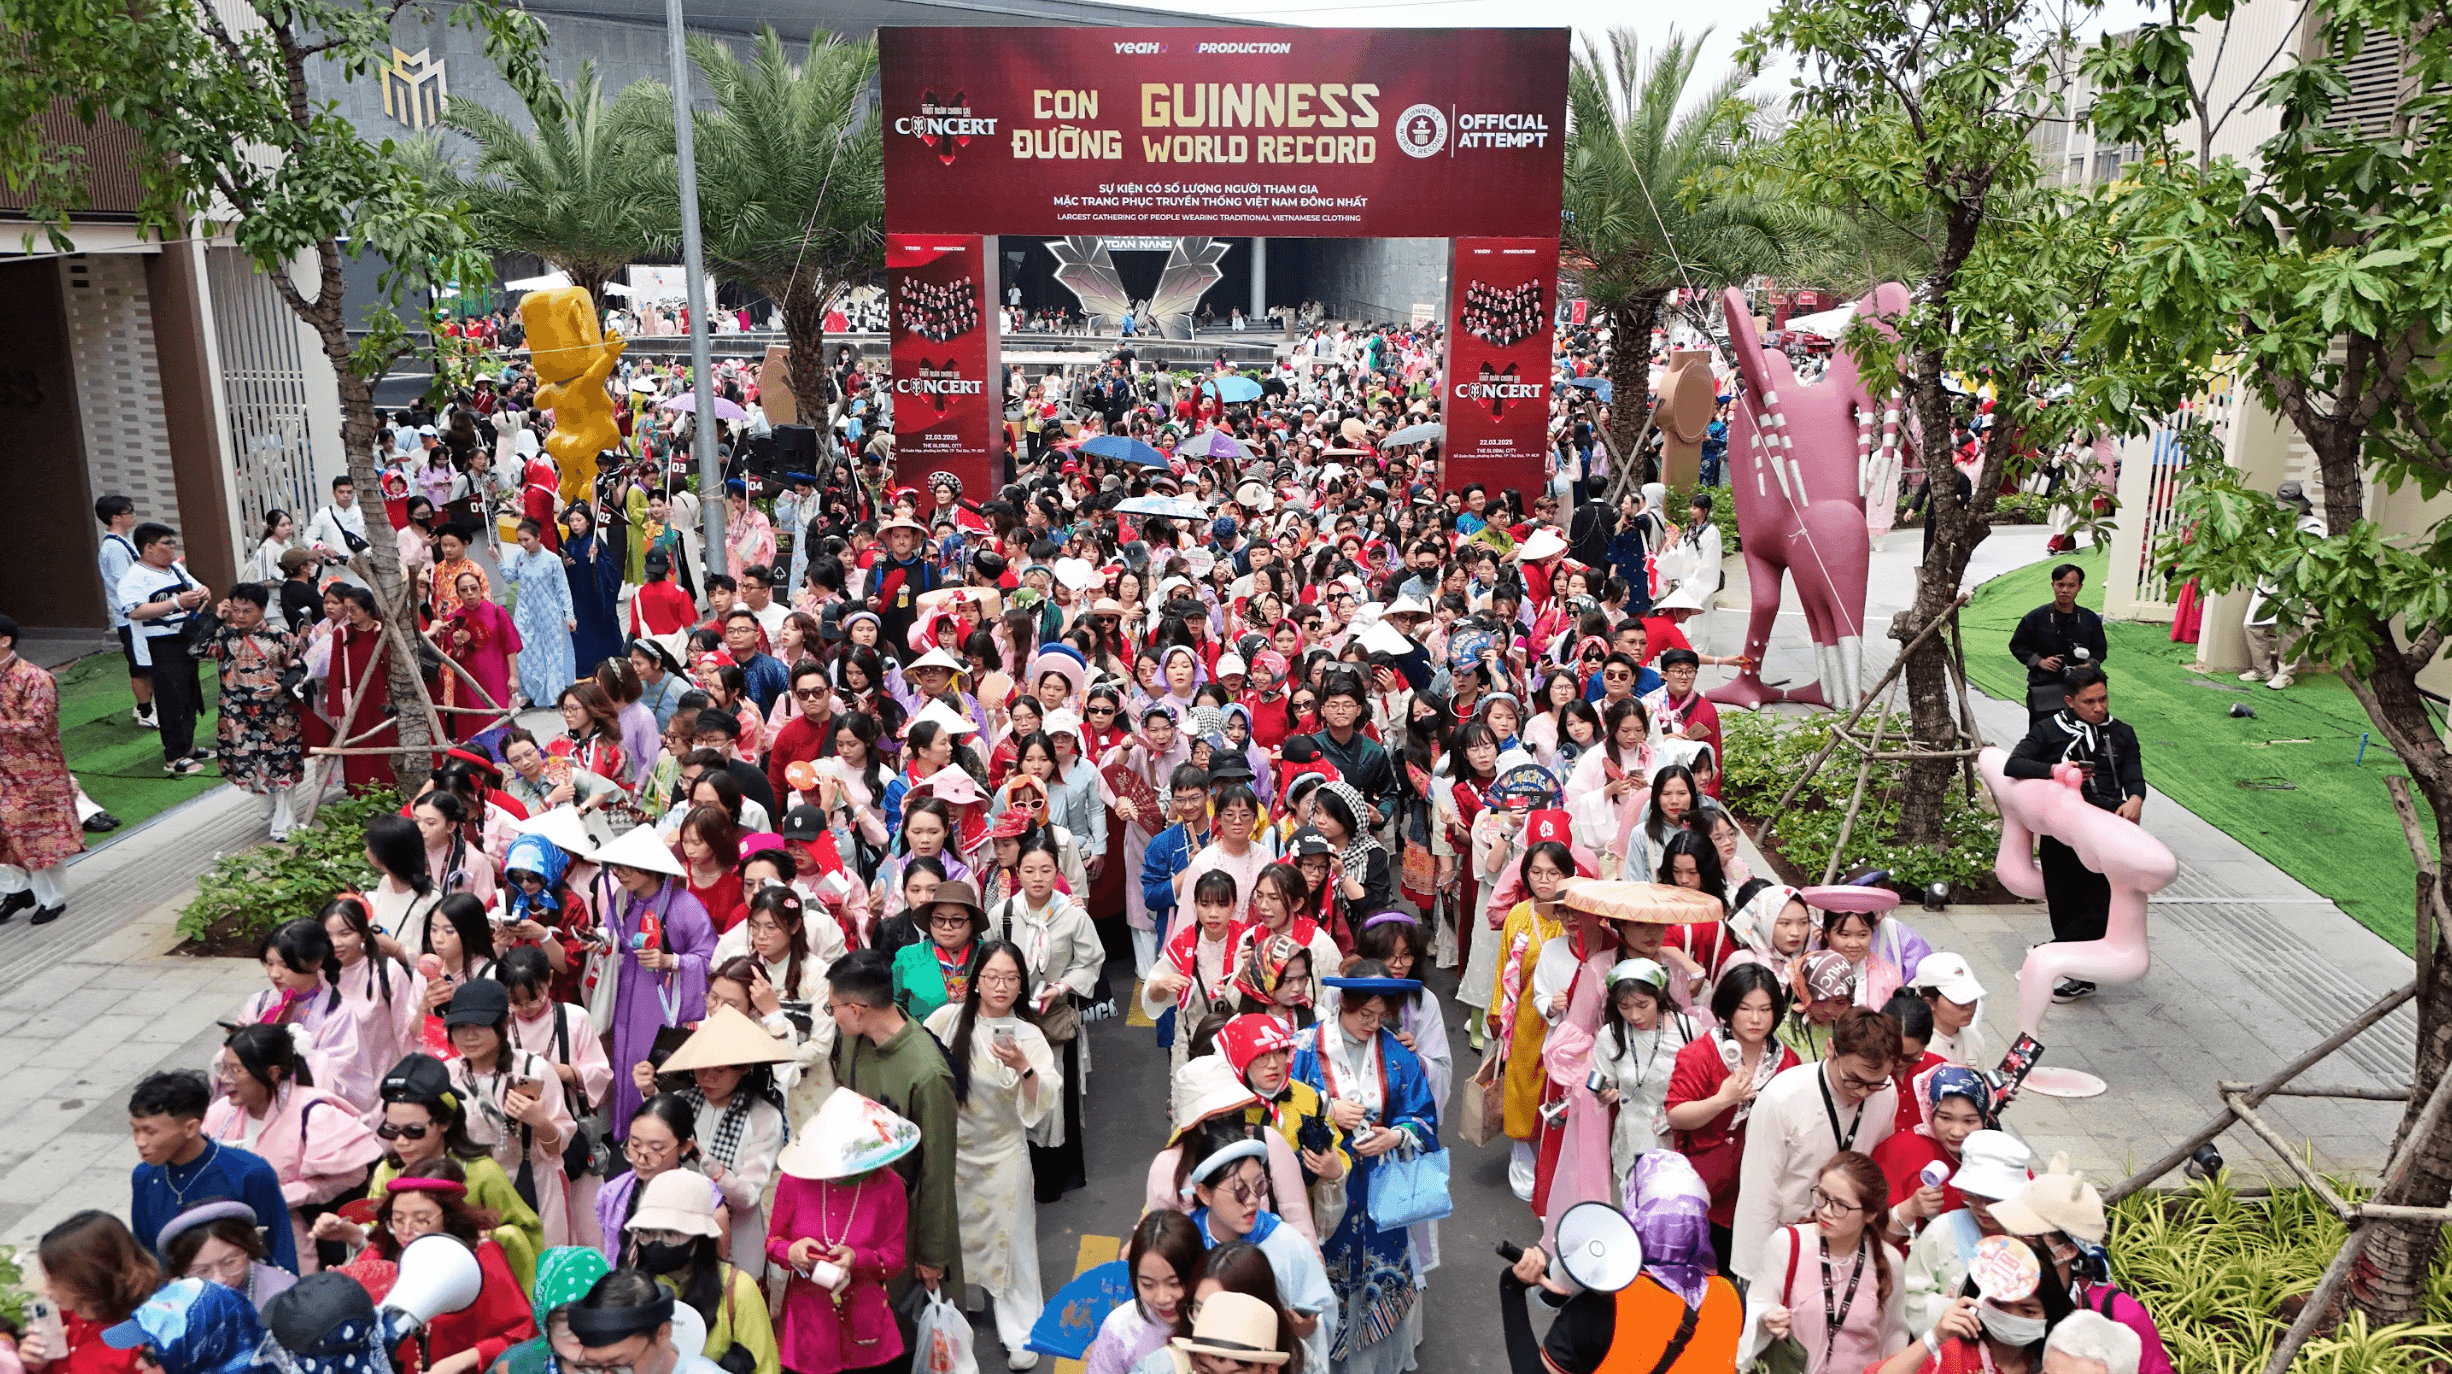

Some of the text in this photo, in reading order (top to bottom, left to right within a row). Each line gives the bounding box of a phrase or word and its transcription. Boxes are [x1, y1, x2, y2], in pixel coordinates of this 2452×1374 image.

[1199, 42, 1292, 54] PRODUCTION
[1033, 89, 1098, 119] CON
[1141, 83, 1380, 128] GUINNESS
[1403, 107, 1441, 122] GUINNESS
[1459, 114, 1548, 130] OFFICIAL
[1011, 124, 1122, 159] ĐƯỜNG
[1400, 127, 1444, 155] WORLD RECORDS
[1458, 132, 1548, 148] ATTEMPT
[1142, 135, 1376, 163] WORLD RECORD
[1099, 181, 1319, 195] SỰ KIỆN CÓ SỐ LƯỢNG NGƯỜI THAM GIA
[1053, 195, 1079, 208] MẶC
[1081, 197, 1119, 206] TRANG
[1122, 197, 1153, 208] PHỤC
[1202, 195, 1242, 206] THỐNG
[1244, 195, 1269, 208] VIỆT
[1271, 198, 1298, 207] NAM
[1300, 196, 1334, 207] ĐÔNG
[1336, 195, 1368, 207] NHẤT
[1057, 213, 1091, 221] LARGEST
[1092, 213, 1136, 221] GATHERING
[1137, 213, 1149, 221] OF
[1150, 213, 1180, 221] PEOPLE
[1272, 214, 1320, 222] VIETNAMESE
[1322, 214, 1361, 222] CLOTHING
[671, 462, 687, 474] 03
[748, 481, 764, 492] 04
[470, 502, 485, 513] 01
[598, 511, 612, 524] 02
